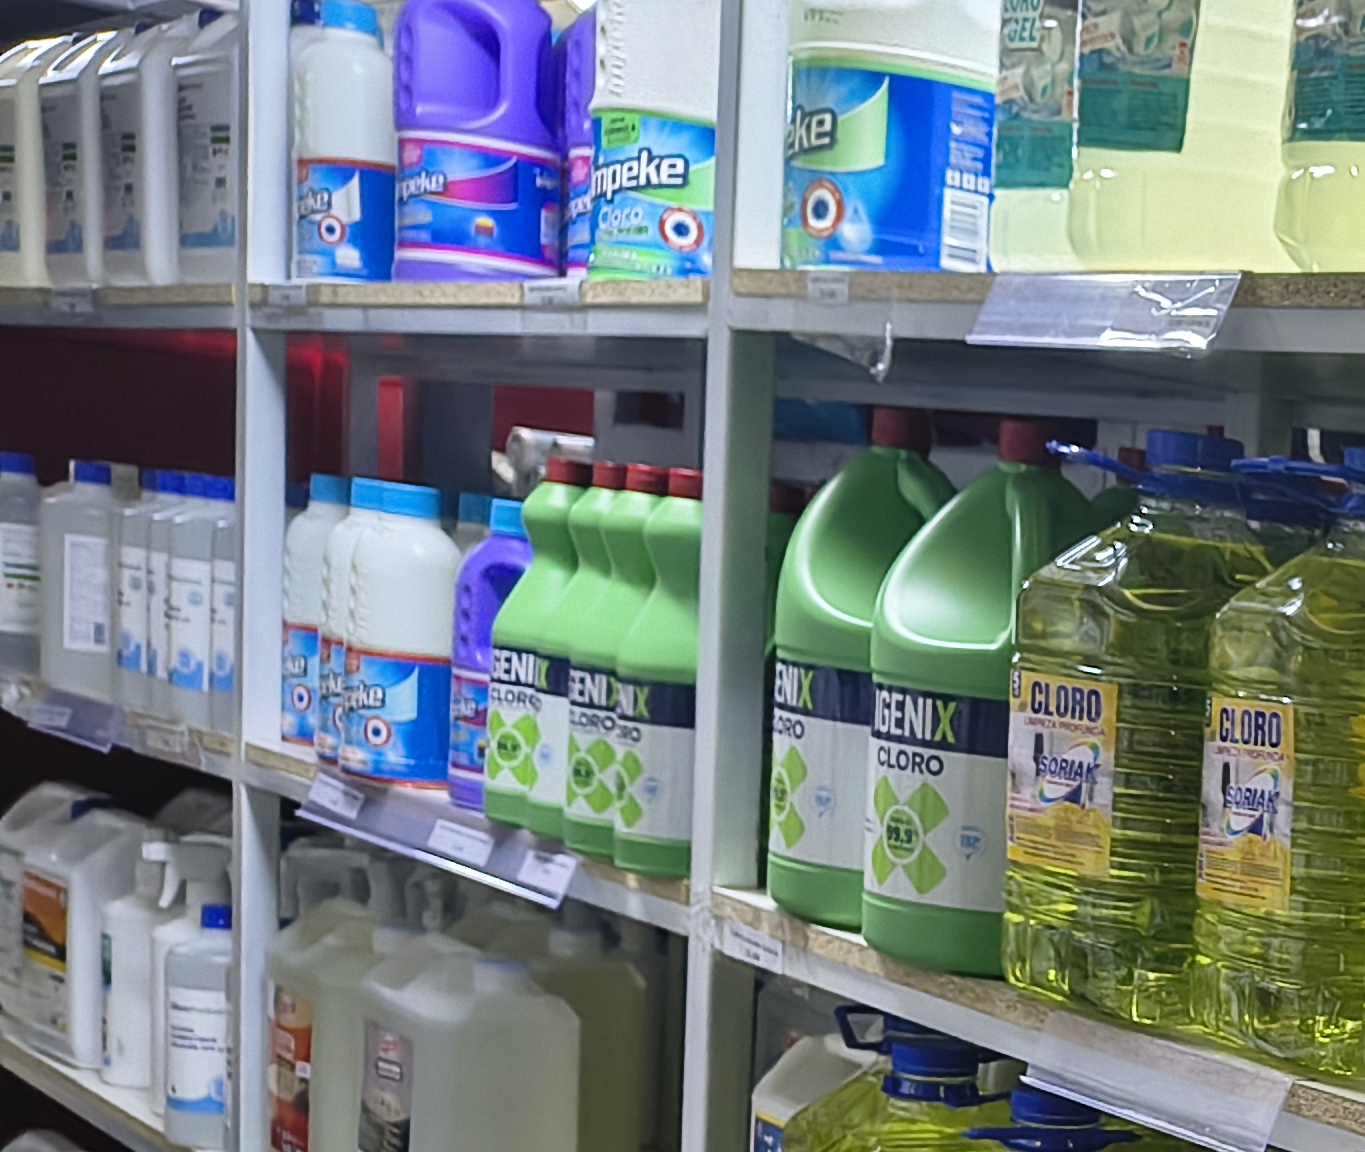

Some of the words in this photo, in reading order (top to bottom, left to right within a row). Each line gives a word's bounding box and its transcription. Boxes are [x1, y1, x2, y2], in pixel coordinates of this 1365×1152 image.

[1006, 18, 1037, 43] GEL
[592, 149, 686, 201] mpeke
[1031, 681, 1102, 723] CLORO
[1220, 707, 1282, 748] CLORO
[877, 746, 944, 776] CLORO
[1039, 754, 1101, 785] SORIAK
[1226, 785, 1280, 814] SORIAK
